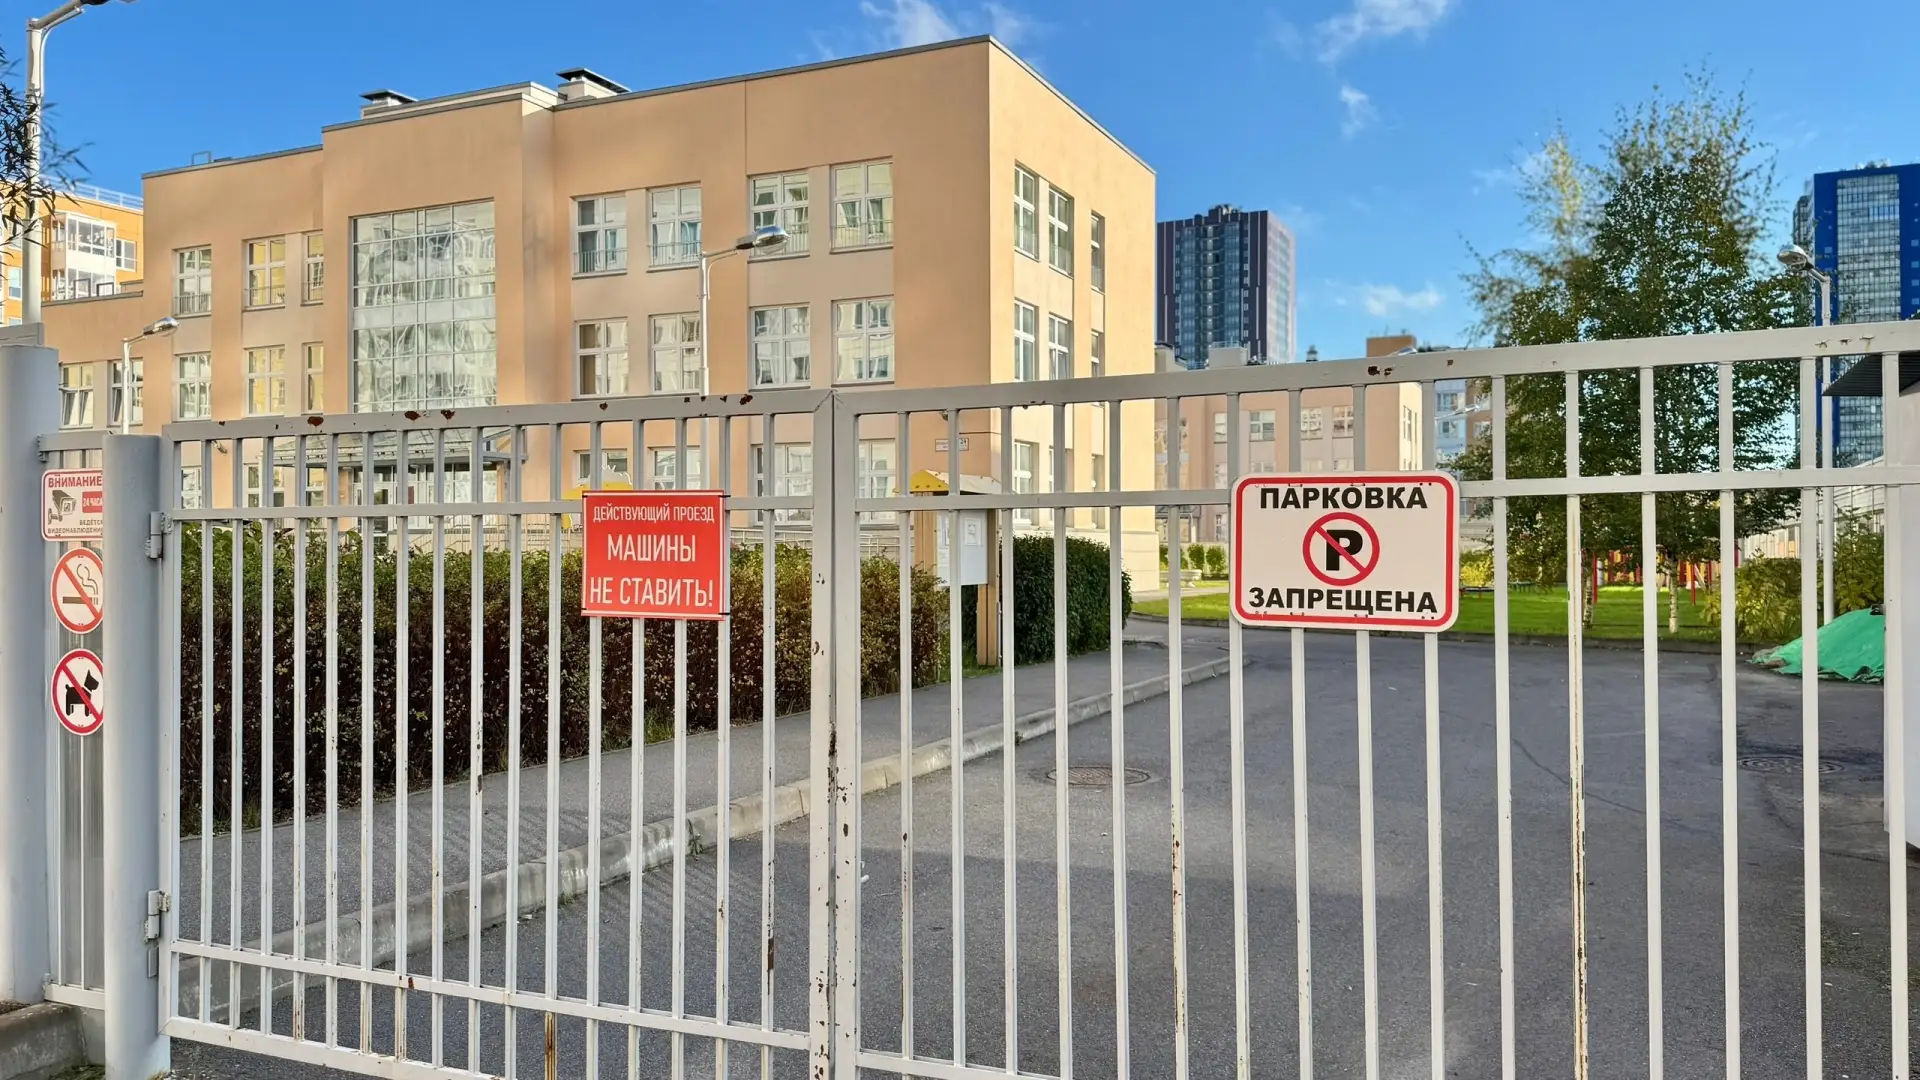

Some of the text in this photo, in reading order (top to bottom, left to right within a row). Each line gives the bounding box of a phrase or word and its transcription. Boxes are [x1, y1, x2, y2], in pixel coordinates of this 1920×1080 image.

[48, 476, 102, 488] ВНИМАНИЕ
[1260, 487, 1428, 509] ПАРКОВКА
[593, 503, 714, 523] ДЕЙСТВУЮЩИЙ ПРОЕЗД
[607, 534, 696, 562] МАШИНЫ
[590, 577, 713, 607] НЕ СТАВИТЬ!
[1249, 587, 1437, 615] ЗАПРЕЩЕНА
